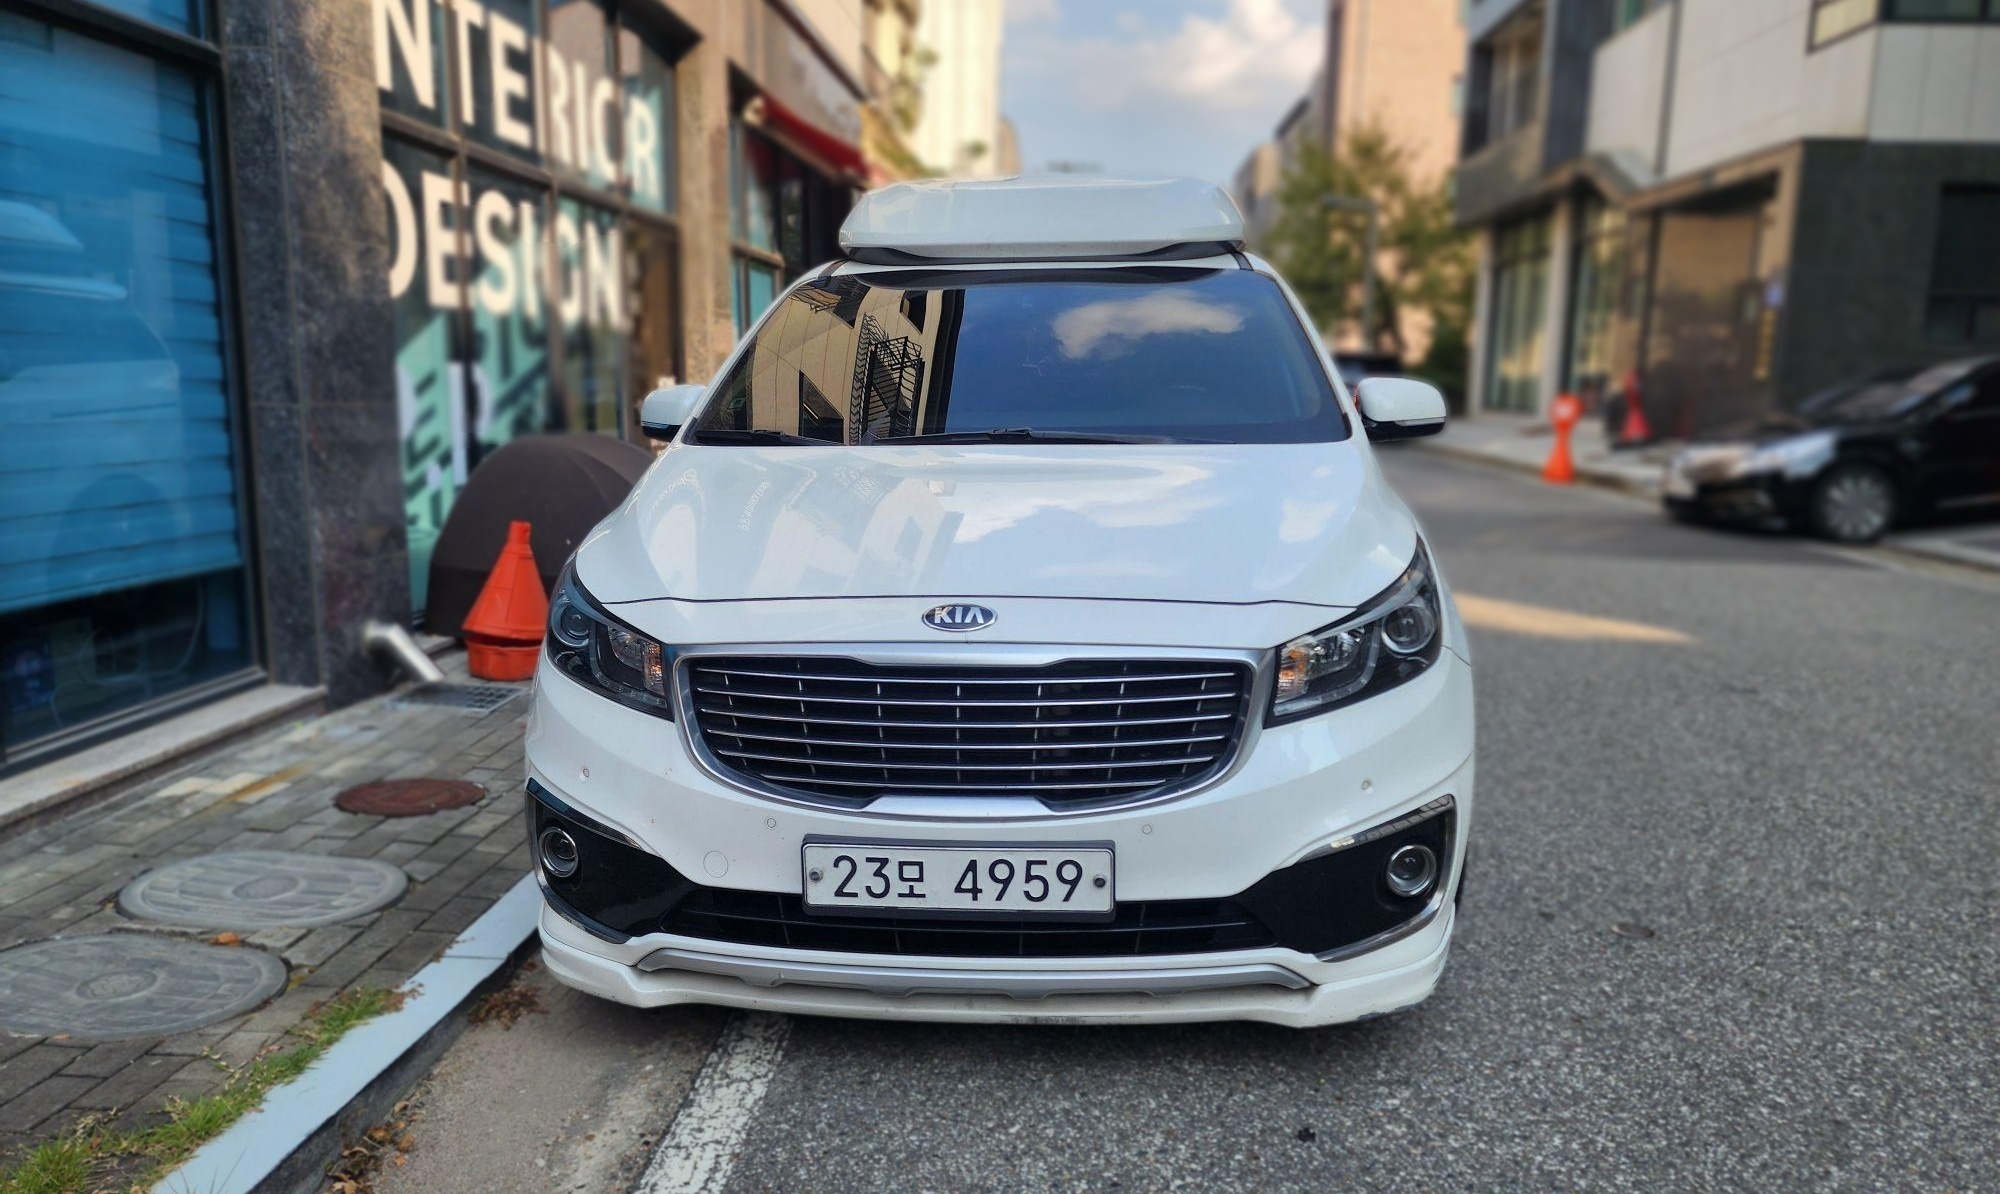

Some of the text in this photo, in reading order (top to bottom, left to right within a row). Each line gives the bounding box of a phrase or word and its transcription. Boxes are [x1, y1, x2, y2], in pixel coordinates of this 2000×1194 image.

[934, 606, 984, 624] KIA
[833, 855, 1083, 902] 23모 4959
